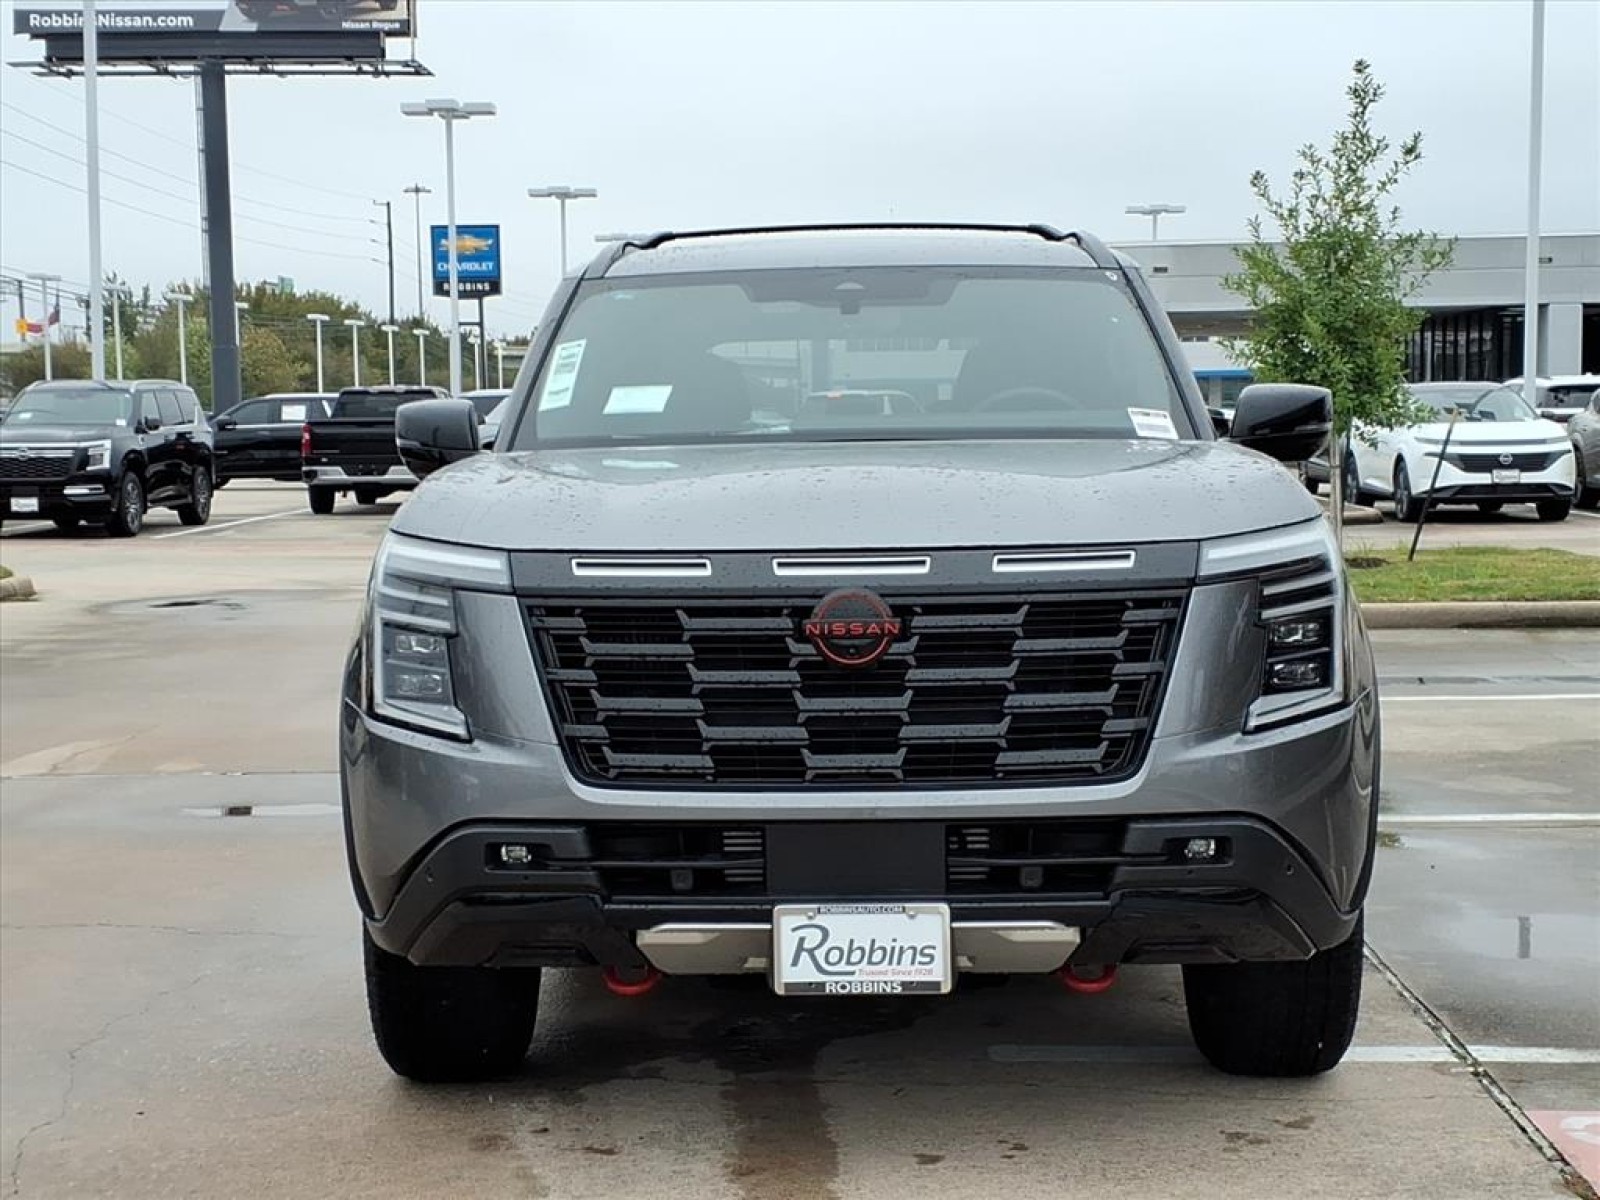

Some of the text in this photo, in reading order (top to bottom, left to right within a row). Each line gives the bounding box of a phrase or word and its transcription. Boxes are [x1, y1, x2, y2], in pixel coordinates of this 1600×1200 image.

[443, 282, 490, 291] RBBINS
[805, 622, 899, 635] NISSAN
[790, 923, 937, 976] Robbins
[825, 981, 903, 994] ROBBINS
